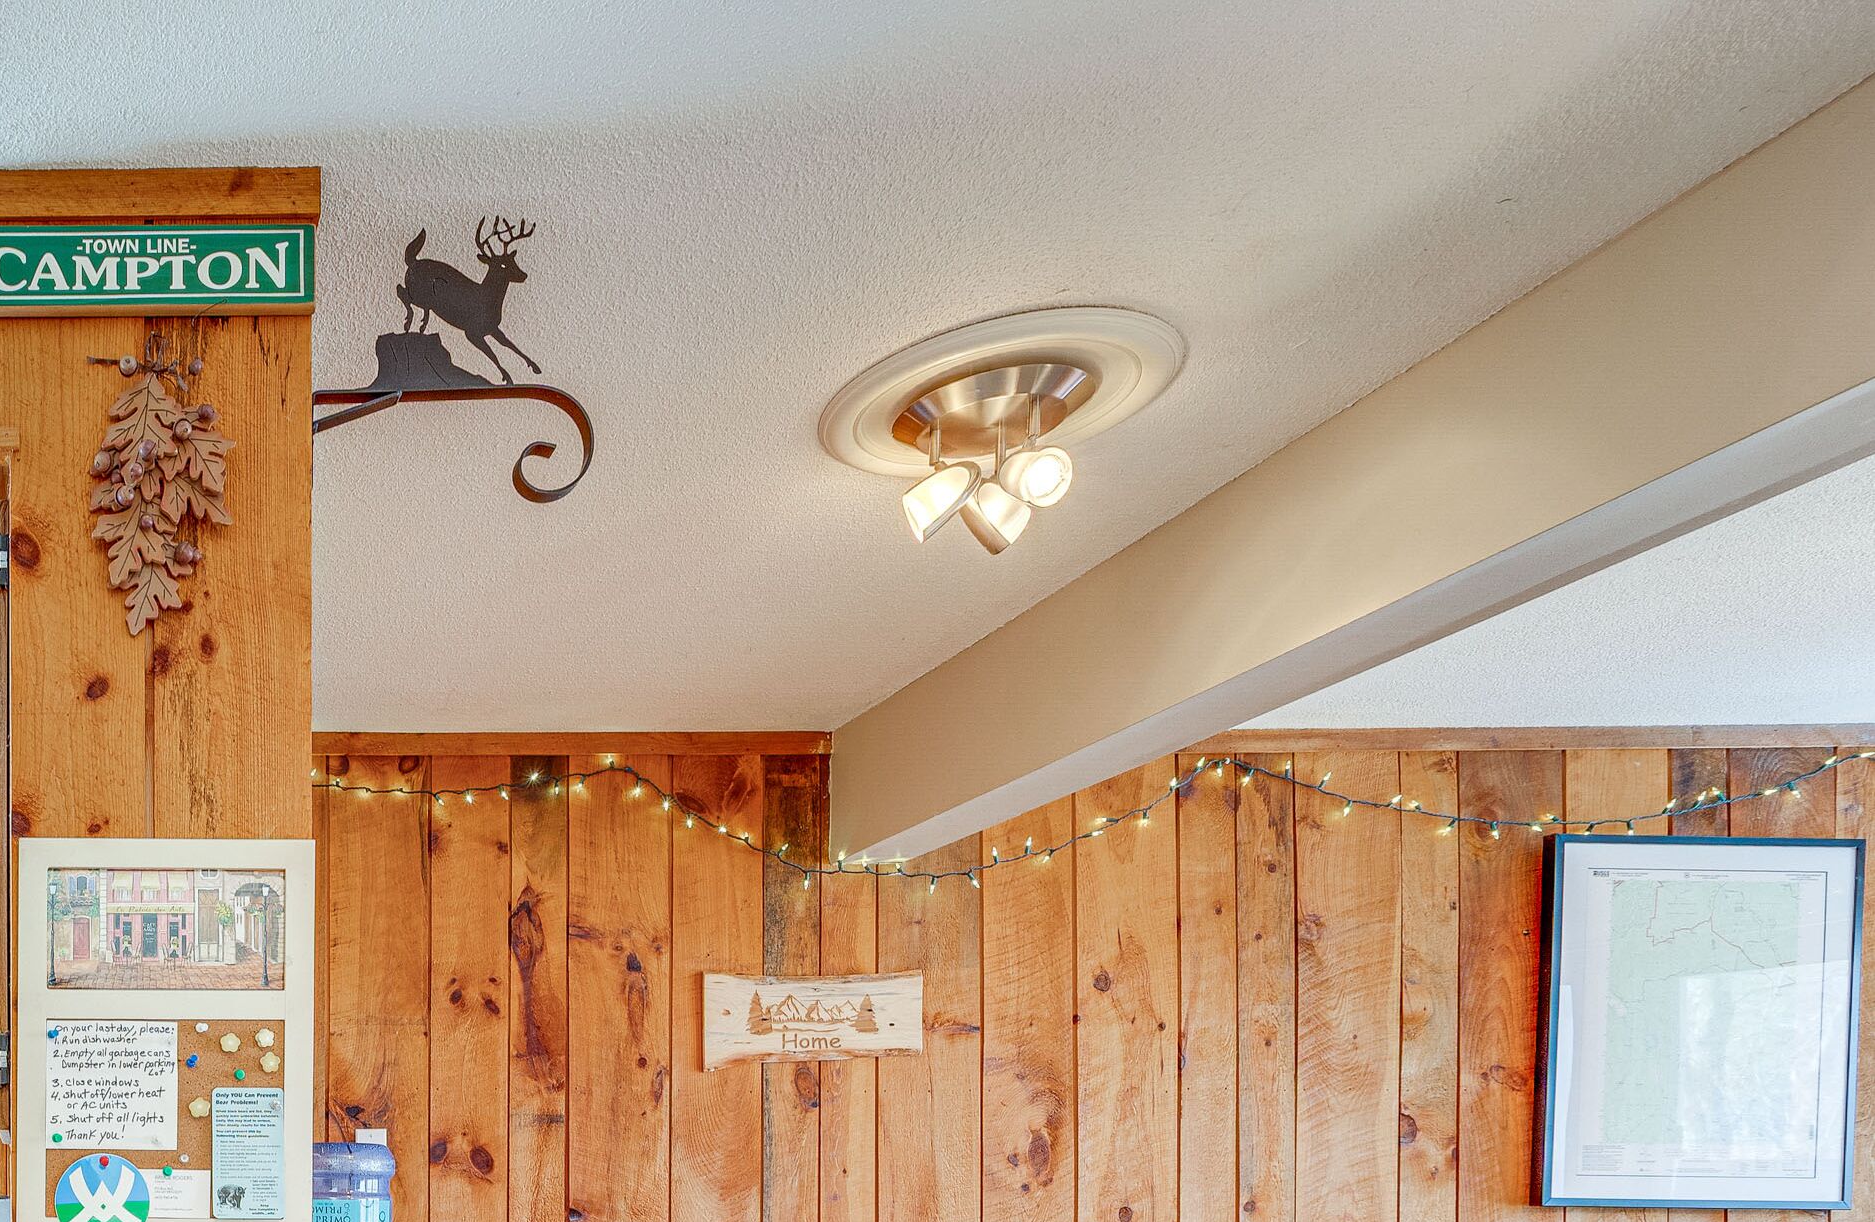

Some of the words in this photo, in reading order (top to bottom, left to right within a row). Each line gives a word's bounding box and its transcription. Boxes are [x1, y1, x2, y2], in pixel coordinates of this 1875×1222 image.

[71, 1025, 92, 1036] your
[96, 1023, 115, 1032] last
[117, 1025, 136, 1036] day,
[140, 1023, 174, 1036] please:
[62, 1036, 79, 1044] Run
[782, 1034, 841, 1049] Home
[53, 1050, 62, 1058] 2.
[64, 1050, 95, 1060] Empty
[97, 1048, 106, 1056] all
[109, 1048, 145, 1061] garbage
[62, 1060, 105, 1071] Dumpster
[108, 1060, 116, 1068] in
[144, 1058, 175, 1073] parking
[52, 1079, 63, 1087] 3.
[95, 1076, 139, 1086] windows
[51, 1092, 60, 1100] 4.
[138, 1087, 165, 1097] heat
[100, 1100, 127, 1109] units
[50, 1115, 62, 1124] 5.
[96, 1113, 113, 1122] off
[117, 1112, 129, 1122] all
[132, 1112, 164, 1127] lights
